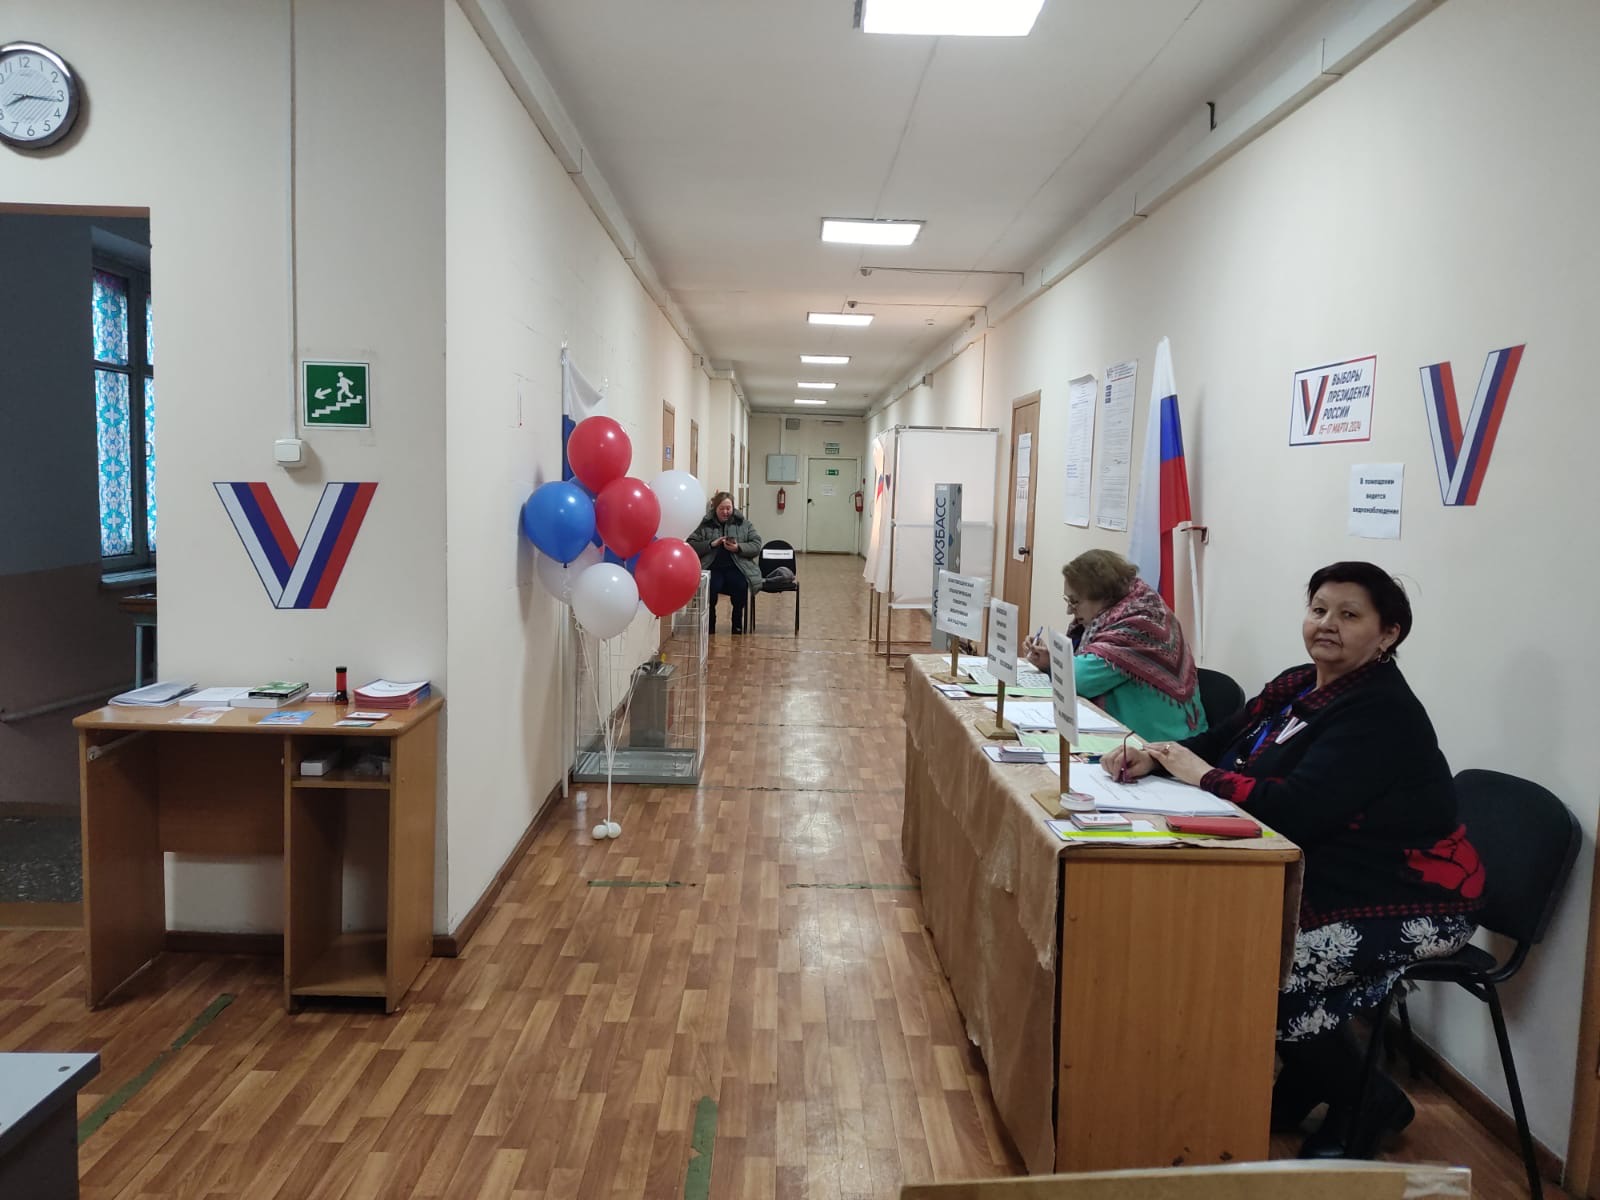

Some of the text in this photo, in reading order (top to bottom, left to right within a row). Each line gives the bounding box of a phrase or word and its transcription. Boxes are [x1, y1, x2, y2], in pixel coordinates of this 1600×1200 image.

[4, 62, 12, 73] 11
[19, 56, 30, 68] 12
[51, 72, 58, 83] 2
[57, 90, 64, 102] 3
[54, 108, 61, 119] 4
[11, 122, 19, 133] 7
[27, 126, 35, 136] 6
[43, 120, 51, 131] 5
[1331, 369, 1362, 386] ВЫБОРЫ
[1327, 384, 1371, 403] ПРЕЗИДЕНТА
[1322, 405, 1350, 420] РОССИИ
[1332, 422, 1348, 432] МАРТА
[1348, 421, 1361, 432] 2024
[1419, 343, 1526, 506] V
[1360, 477, 1363, 485] В
[935, 497, 946, 566] КУЗБАСС
[213, 482, 378, 609] V
